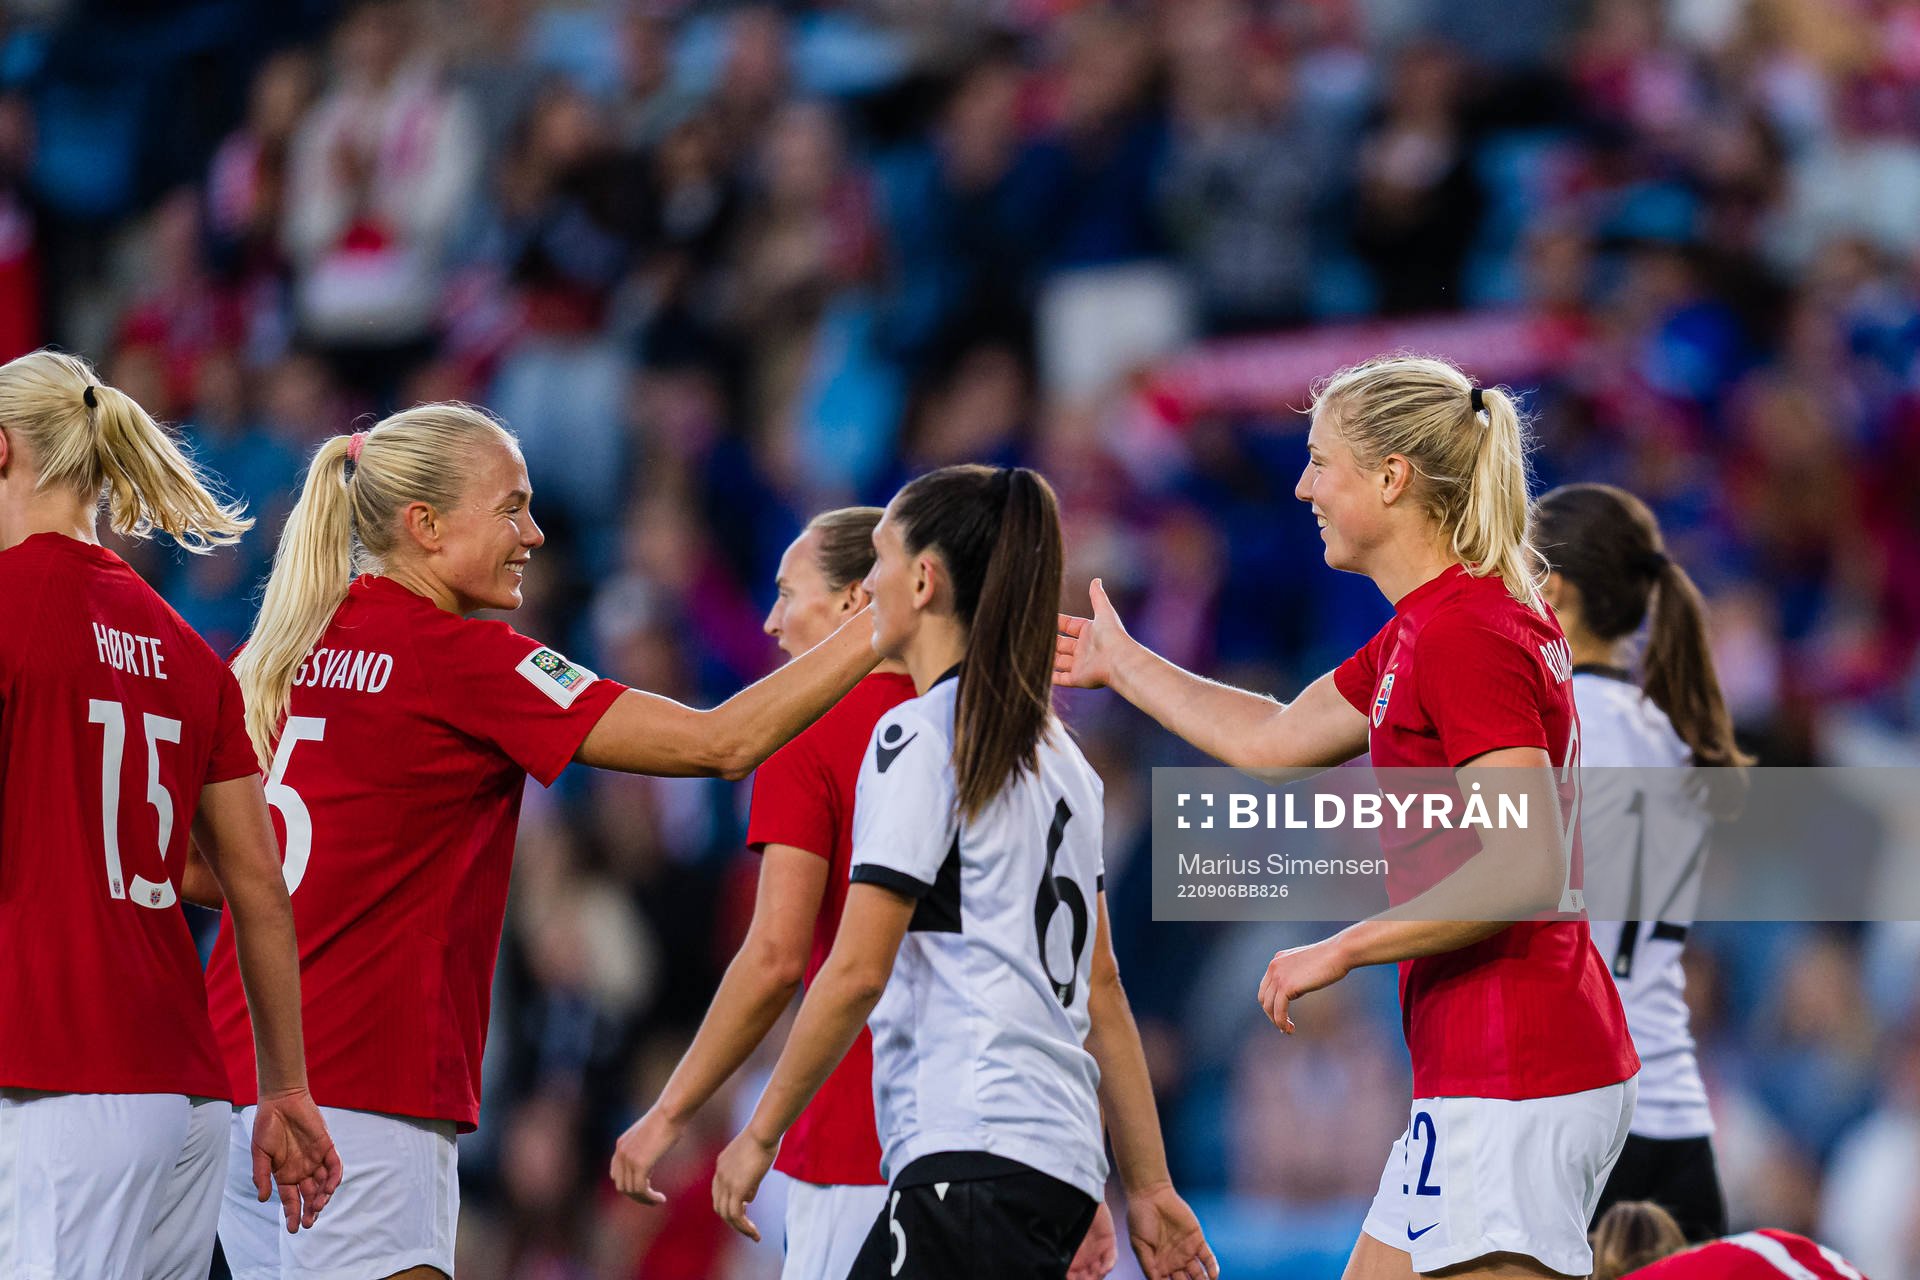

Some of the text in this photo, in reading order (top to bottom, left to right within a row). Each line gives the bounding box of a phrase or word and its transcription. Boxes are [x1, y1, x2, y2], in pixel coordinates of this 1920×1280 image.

[92, 622, 168, 680] HØRTE
[88, 698, 182, 909] 15
[1034, 796, 1088, 1010] 6
[1402, 1110, 1441, 1196] 2
